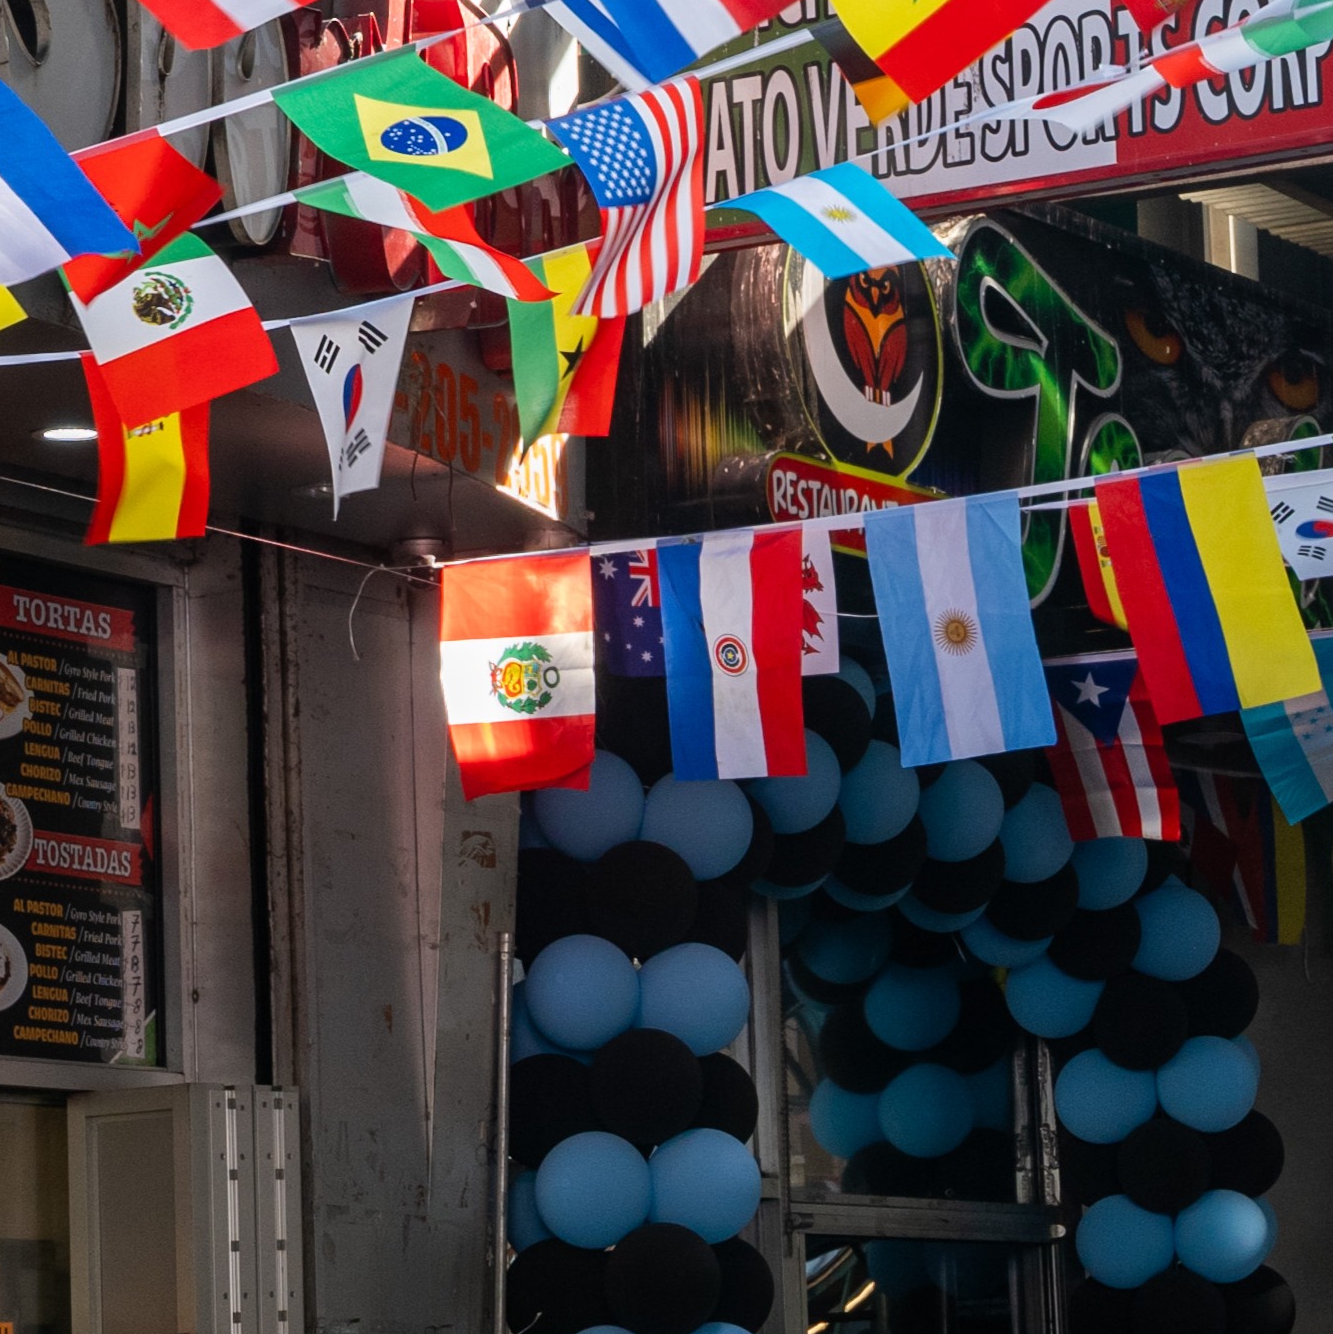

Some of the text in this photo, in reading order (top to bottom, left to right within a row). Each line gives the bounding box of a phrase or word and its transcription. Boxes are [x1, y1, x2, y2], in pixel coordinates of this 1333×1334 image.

[704, 67, 803, 204] ATO
[13, 594, 112, 639] TORTAS
[21, 652, 57, 672] PASTOR
[25, 676, 71, 696] CARNITAS
[28, 696, 62, 716] BISTEC
[23, 719, 52, 737] POLLO
[24, 742, 60, 760] LENGUA
[20, 763, 62, 781] CHORIZO
[5, 782, 71, 806] CAMPECHANO
[34, 837, 131, 878] TOSTADAS
[26, 900, 64, 917] PASTOR
[31, 922, 77, 941] CARNITAS
[35, 943, 68, 960] BISTEC
[29, 964, 59, 980] POLLO
[32, 985, 69, 1003] LENGUA
[28, 1006, 70, 1024] CHORIZO
[13, 1026, 79, 1046] CAMPECHANO
